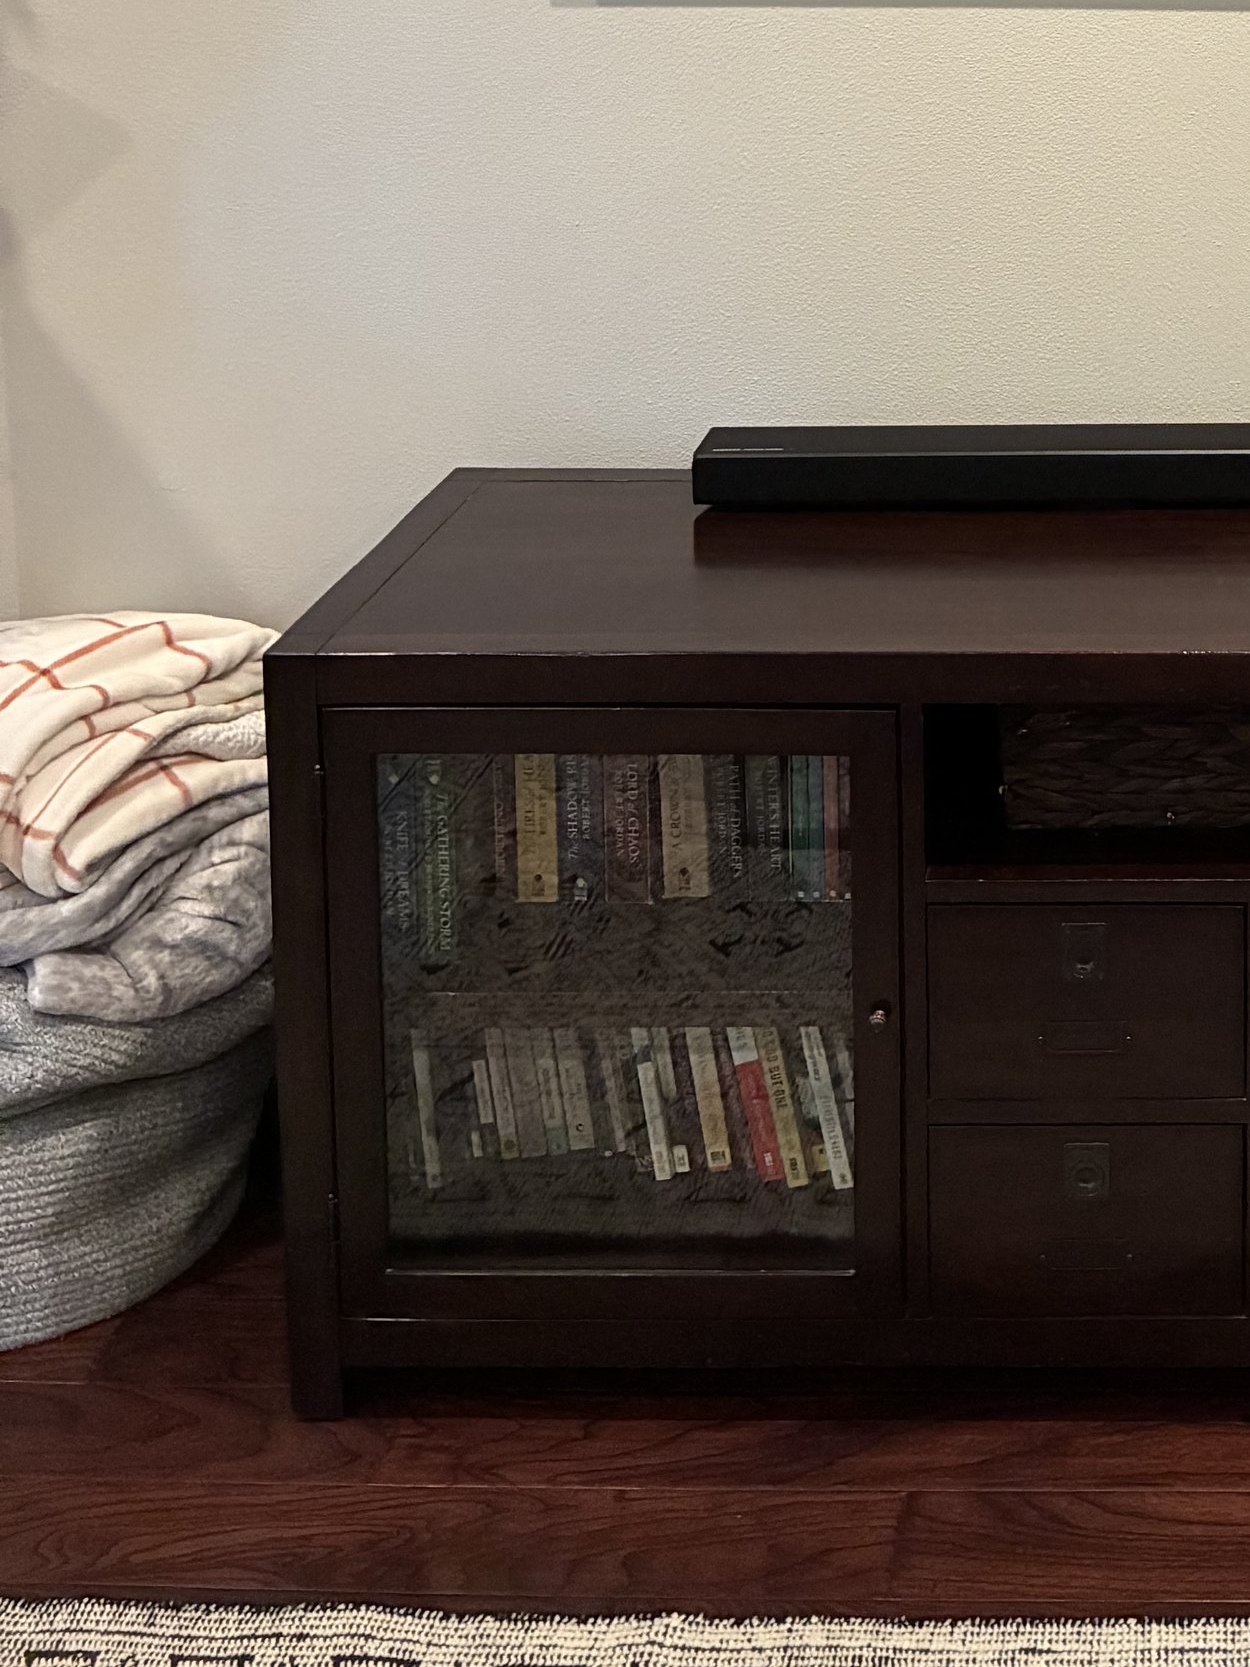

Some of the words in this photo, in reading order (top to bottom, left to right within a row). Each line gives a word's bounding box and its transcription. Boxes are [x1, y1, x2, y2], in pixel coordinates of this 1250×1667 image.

[626, 764, 638, 801] LORD
[437, 815, 450, 898] GATHERING
[627, 817, 640, 864] CHAOS
[439, 901, 451, 950] STORM
[768, 1066, 784, 1086] BUT
